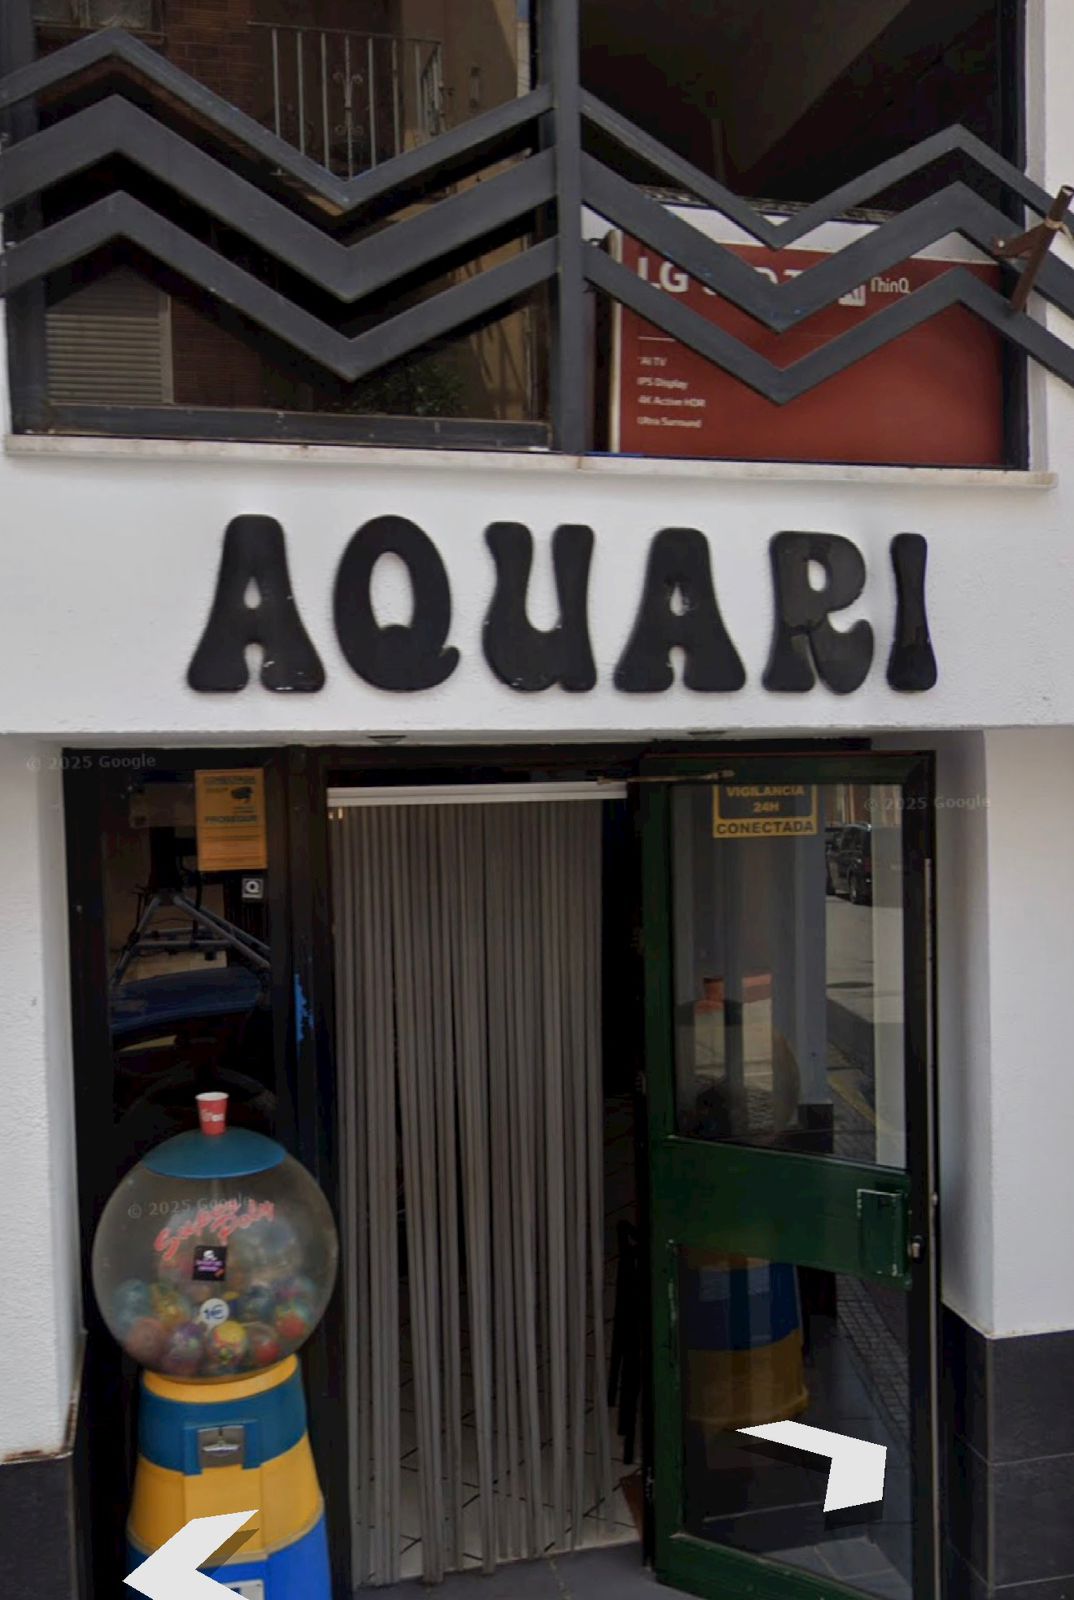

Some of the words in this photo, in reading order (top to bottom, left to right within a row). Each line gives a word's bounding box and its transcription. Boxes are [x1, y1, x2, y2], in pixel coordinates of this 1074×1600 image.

[638, 256, 689, 292] LG
[870, 276, 911, 294] ThinQ
[187, 514, 937, 695] AQUARI
[726, 784, 805, 798] VIGILANCIA
[753, 801, 780, 814] 24H
[716, 820, 815, 835] CONECTADA
